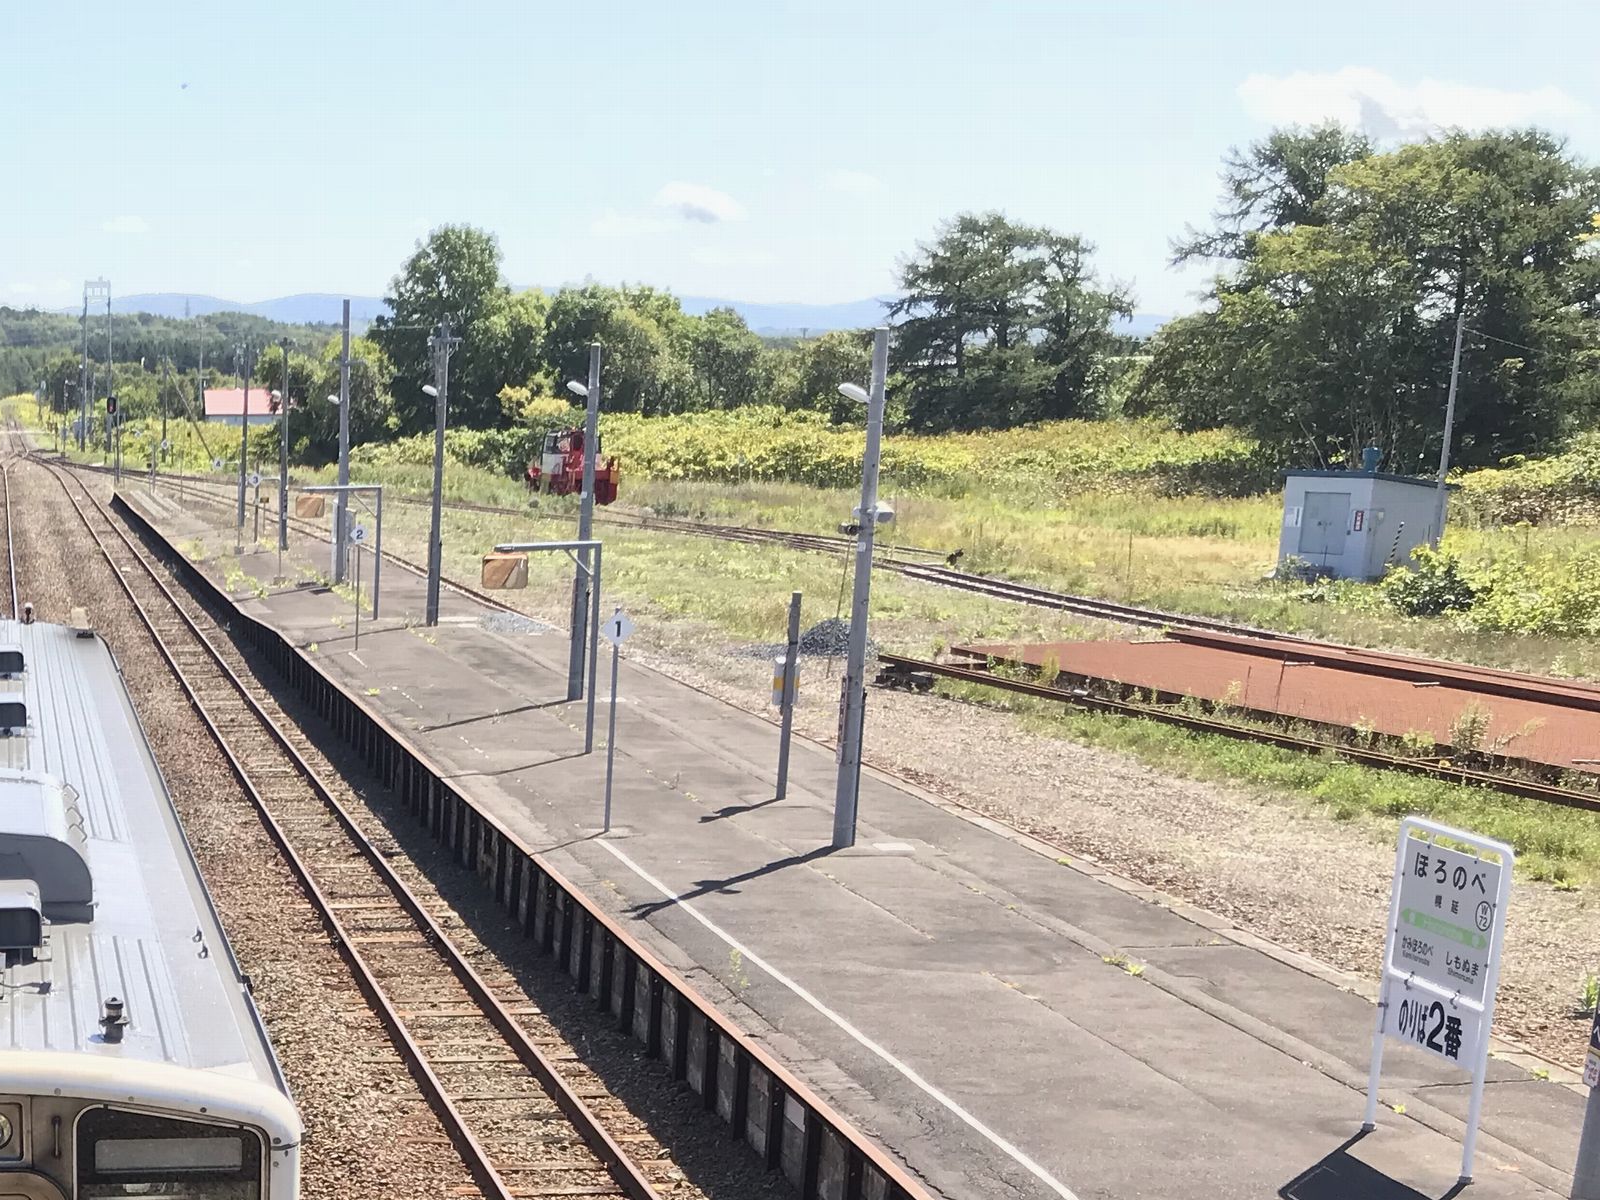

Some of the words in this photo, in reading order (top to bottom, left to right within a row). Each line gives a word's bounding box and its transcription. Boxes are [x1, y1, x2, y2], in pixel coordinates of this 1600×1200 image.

[356, 529, 364, 539] 2
[615, 620, 621, 638] 1
[1414, 852, 1486, 895] ほろのべ
[1479, 915, 1488, 928] 72
[1446, 951, 1479, 977] しもぬま
